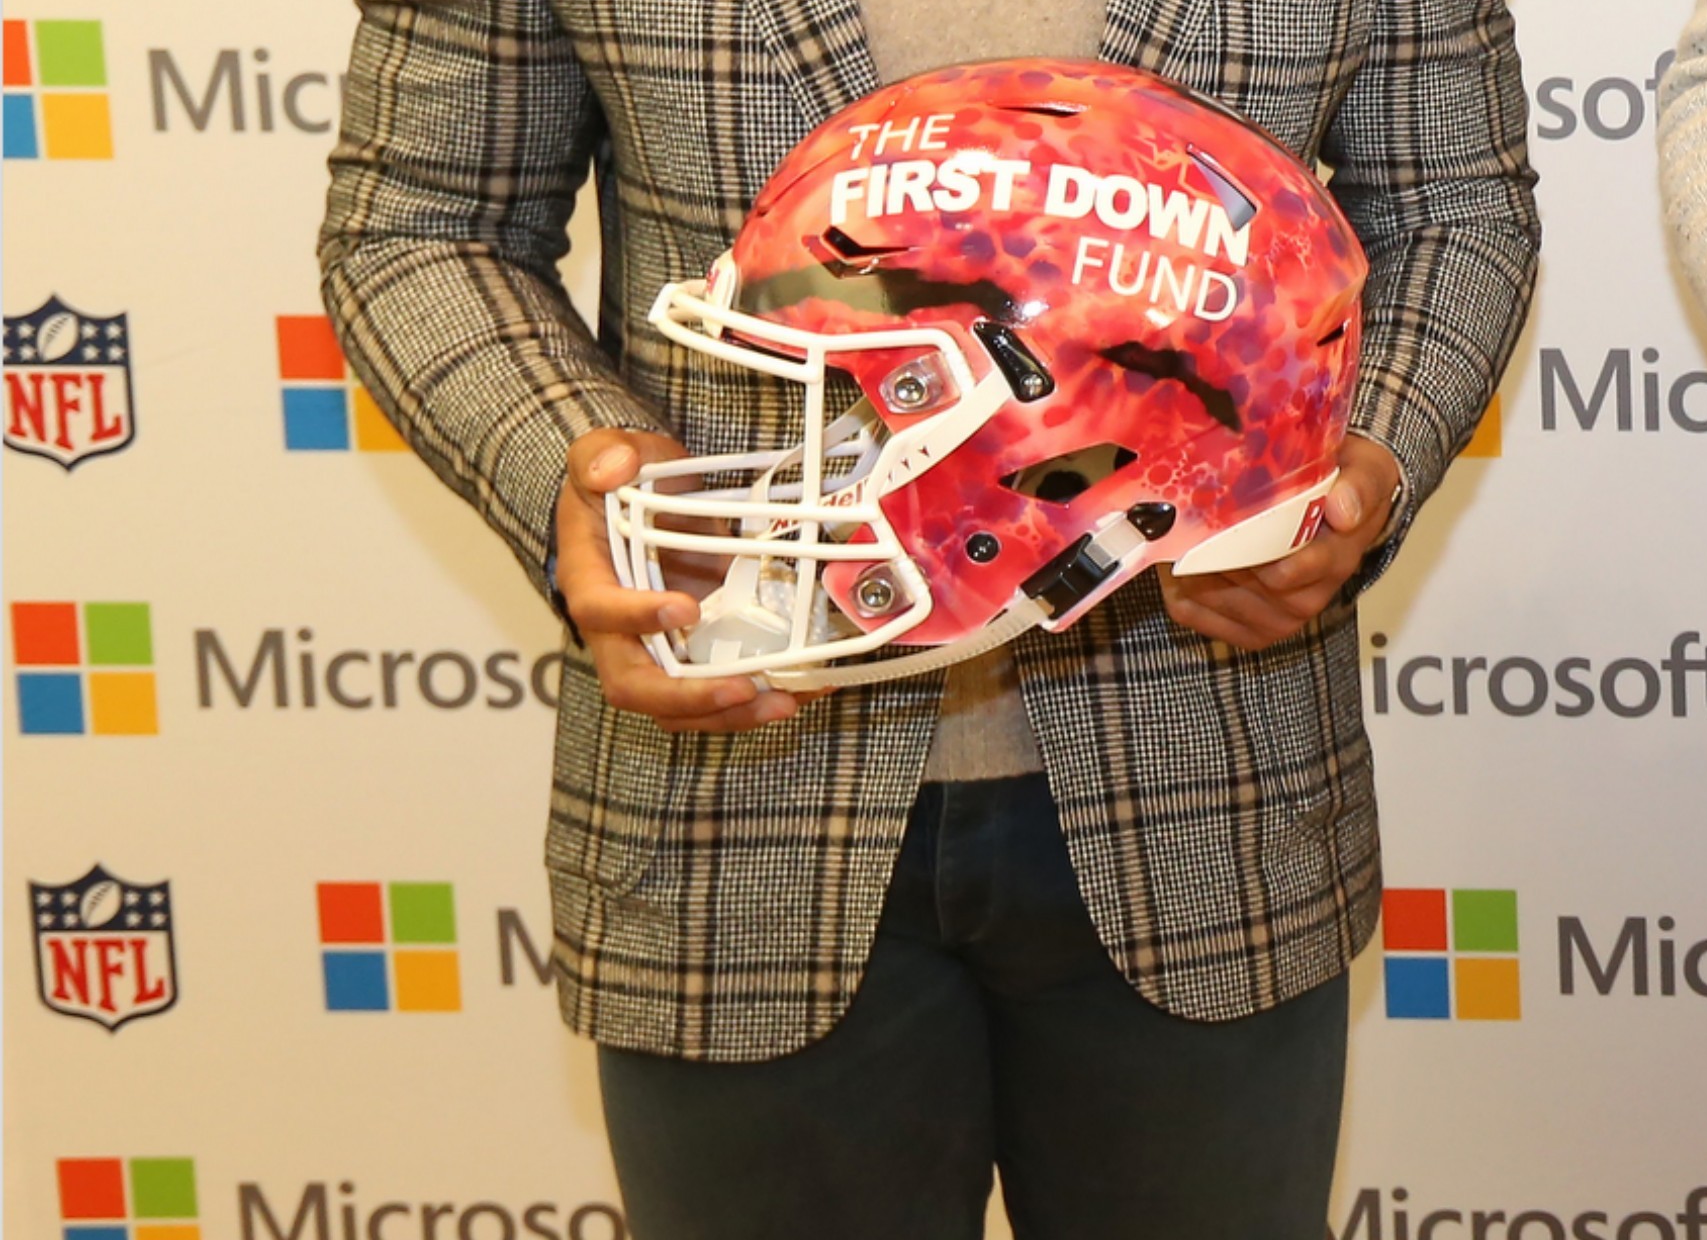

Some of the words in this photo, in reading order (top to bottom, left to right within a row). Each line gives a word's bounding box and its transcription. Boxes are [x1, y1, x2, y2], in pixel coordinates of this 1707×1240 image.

[849, 114, 955, 160] THE
[830, 159, 1030, 224] FIRST
[1044, 163, 1251, 266] DOWN
[1071, 236, 1237, 321] FUND
[6, 373, 122, 450] NFL
[50, 938, 166, 1011] NFL
[239, 1195, 628, 1240] Microso
